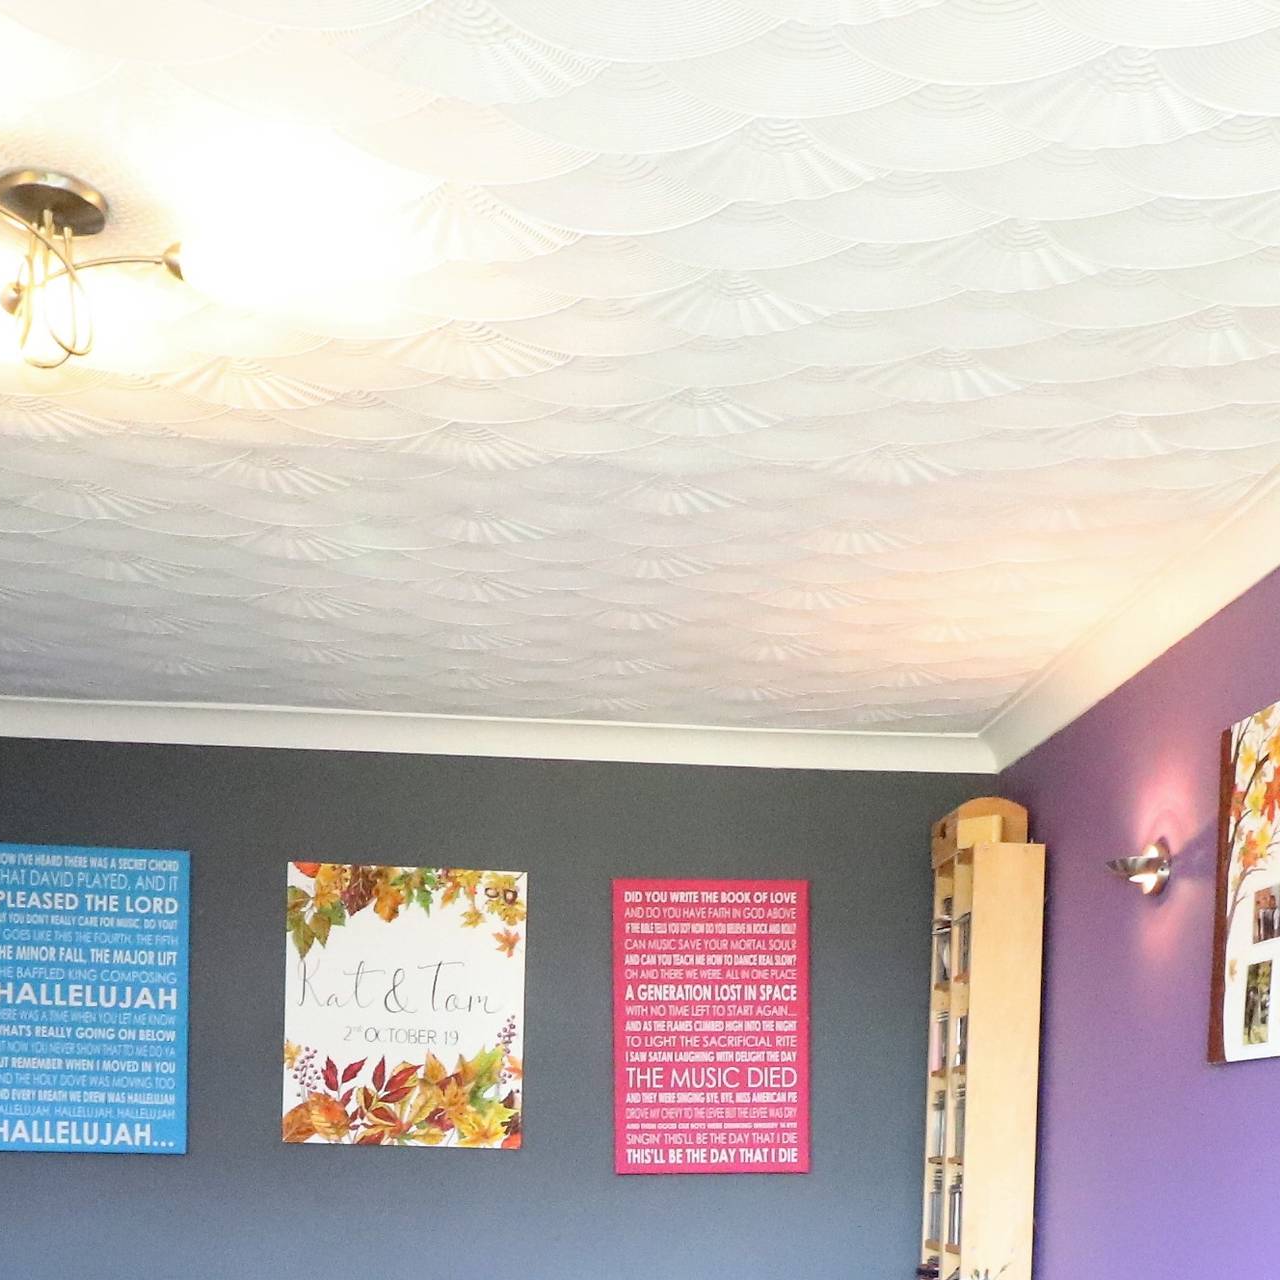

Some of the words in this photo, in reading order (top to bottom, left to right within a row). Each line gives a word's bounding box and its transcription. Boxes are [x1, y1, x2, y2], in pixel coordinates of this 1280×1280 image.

[30, 870, 73, 887] DAVID
[135, 874, 165, 890] AND
[168, 876, 178, 891] IT
[84, 894, 118, 911] THE
[125, 895, 177, 913] LORD
[624, 891, 642, 903] DID
[645, 891, 667, 903] YOU
[670, 891, 698, 903] WRITE
[700, 891, 718, 903] THE
[720, 892, 750, 903] BOOK
[753, 892, 767, 903] OF
[769, 892, 796, 903] LOVE
[624, 907, 644, 918] AND
[647, 907, 660, 918] DO
[662, 907, 681, 918] YOU
[682, 907, 706, 918] HAVE
[708, 907, 731, 918] FAITH
[733, 907, 740, 918] IN
[743, 907, 764, 919] GOD
[766, 907, 796, 919] ABOVE
[624, 939, 646, 950] CAN
[649, 939, 676, 950] MUSIC
[678, 939, 702, 950] SAVE
[703, 939, 727, 950] YOUR
[730, 939, 766, 950] MORTAL
[16, 945, 55, 961] MINOR
[90, 948, 109, 963] THE
[112, 949, 154, 964] MAJOR
[157, 951, 177, 965] LIFT
[16, 966, 64, 979] BAFFLED
[68, 968, 96, 980] KING
[100, 969, 176, 983] COMPOSING
[297, 958, 386, 1009] Kat
[384, 968, 418, 1014] &
[418, 960, 503, 1014] Tom
[624, 984, 634, 1000] A
[637, 984, 711, 1001] GENERATION
[715, 984, 742, 1001] LOST
[744, 985, 755, 1001] IN
[759, 985, 796, 1001] SPACE
[625, 1005, 647, 1016] WITH
[650, 1005, 665, 1016] NO
[668, 1005, 688, 1016] TIME
[691, 1005, 710, 1016] LEFT
[712, 1005, 725, 1016] TO
[727, 1005, 753, 1016] START
[35, 1026, 71, 1037] REALLY
[75, 1027, 115, 1039] GOING
[118, 1028, 135, 1039] ON
[138, 1029, 176, 1041] BELOW
[364, 1027, 437, 1045] OCTOBER
[444, 1031, 459, 1045] 19
[625, 1036, 641, 1047] TO
[645, 1036, 676, 1047] LIGHT
[680, 1036, 700, 1047] THE
[703, 1036, 772, 1047] SACRIFICIAL
[775, 1036, 796, 1047] RITE
[12, 1057, 62, 1069] REMEMBER
[65, 1058, 93, 1070] WHEN
[96, 1059, 99, 1070] I
[102, 1060, 138, 1071] MOVED
[141, 1061, 151, 1072] IN
[154, 1061, 175, 1072] YOU
[626, 1067, 663, 1088] THE
[670, 1067, 740, 1088] MUSIC
[747, 1067, 797, 1088] DIED
[663, 1133, 693, 1144] THIS'LL
[696, 1133, 708, 1144] BE
[710, 1133, 727, 1144] THE
[729, 1133, 749, 1144] DAY
[751, 1133, 774, 1144] THAT
[778, 1133, 781, 1144] I
[782, 1133, 797, 1144] DIE
[626, 1148, 665, 1163] THIS'LL
[668, 1148, 682, 1163] BE
[685, 1148, 707, 1163] THE
[710, 1148, 736, 1163] DAY
[739, 1148, 769, 1164] THAT
[772, 1148, 775, 1164] I
[779, 1148, 798, 1164] DIE
